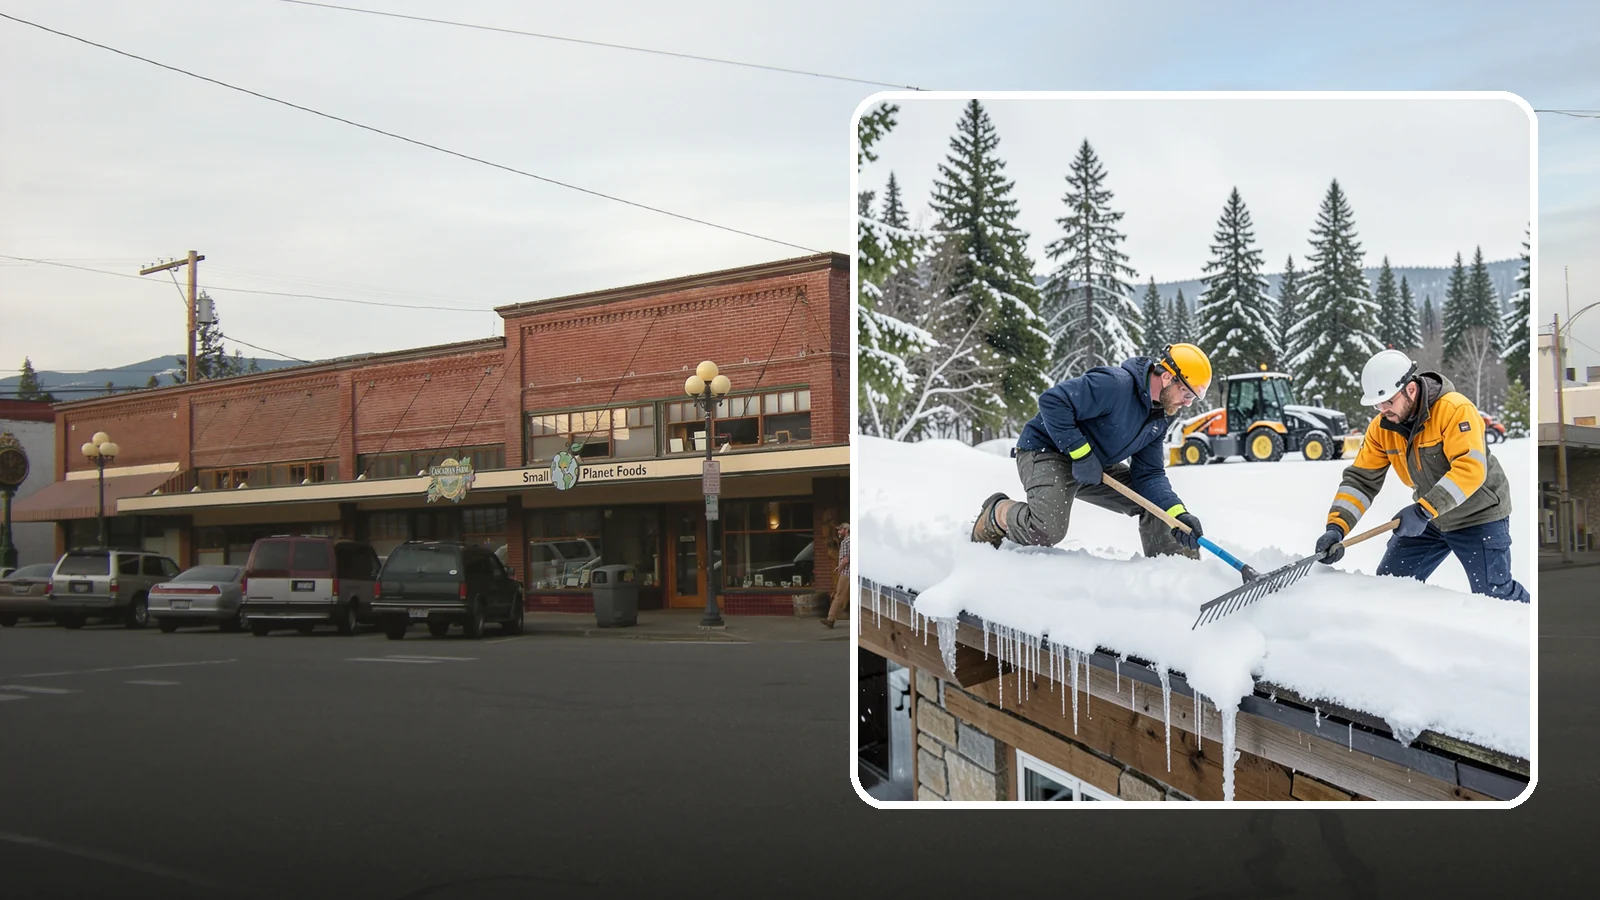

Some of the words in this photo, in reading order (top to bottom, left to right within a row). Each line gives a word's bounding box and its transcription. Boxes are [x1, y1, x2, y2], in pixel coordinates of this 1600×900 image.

[523, 470, 549, 483] Small
[583, 467, 614, 479] Planet
[617, 464, 647, 476] Foods
